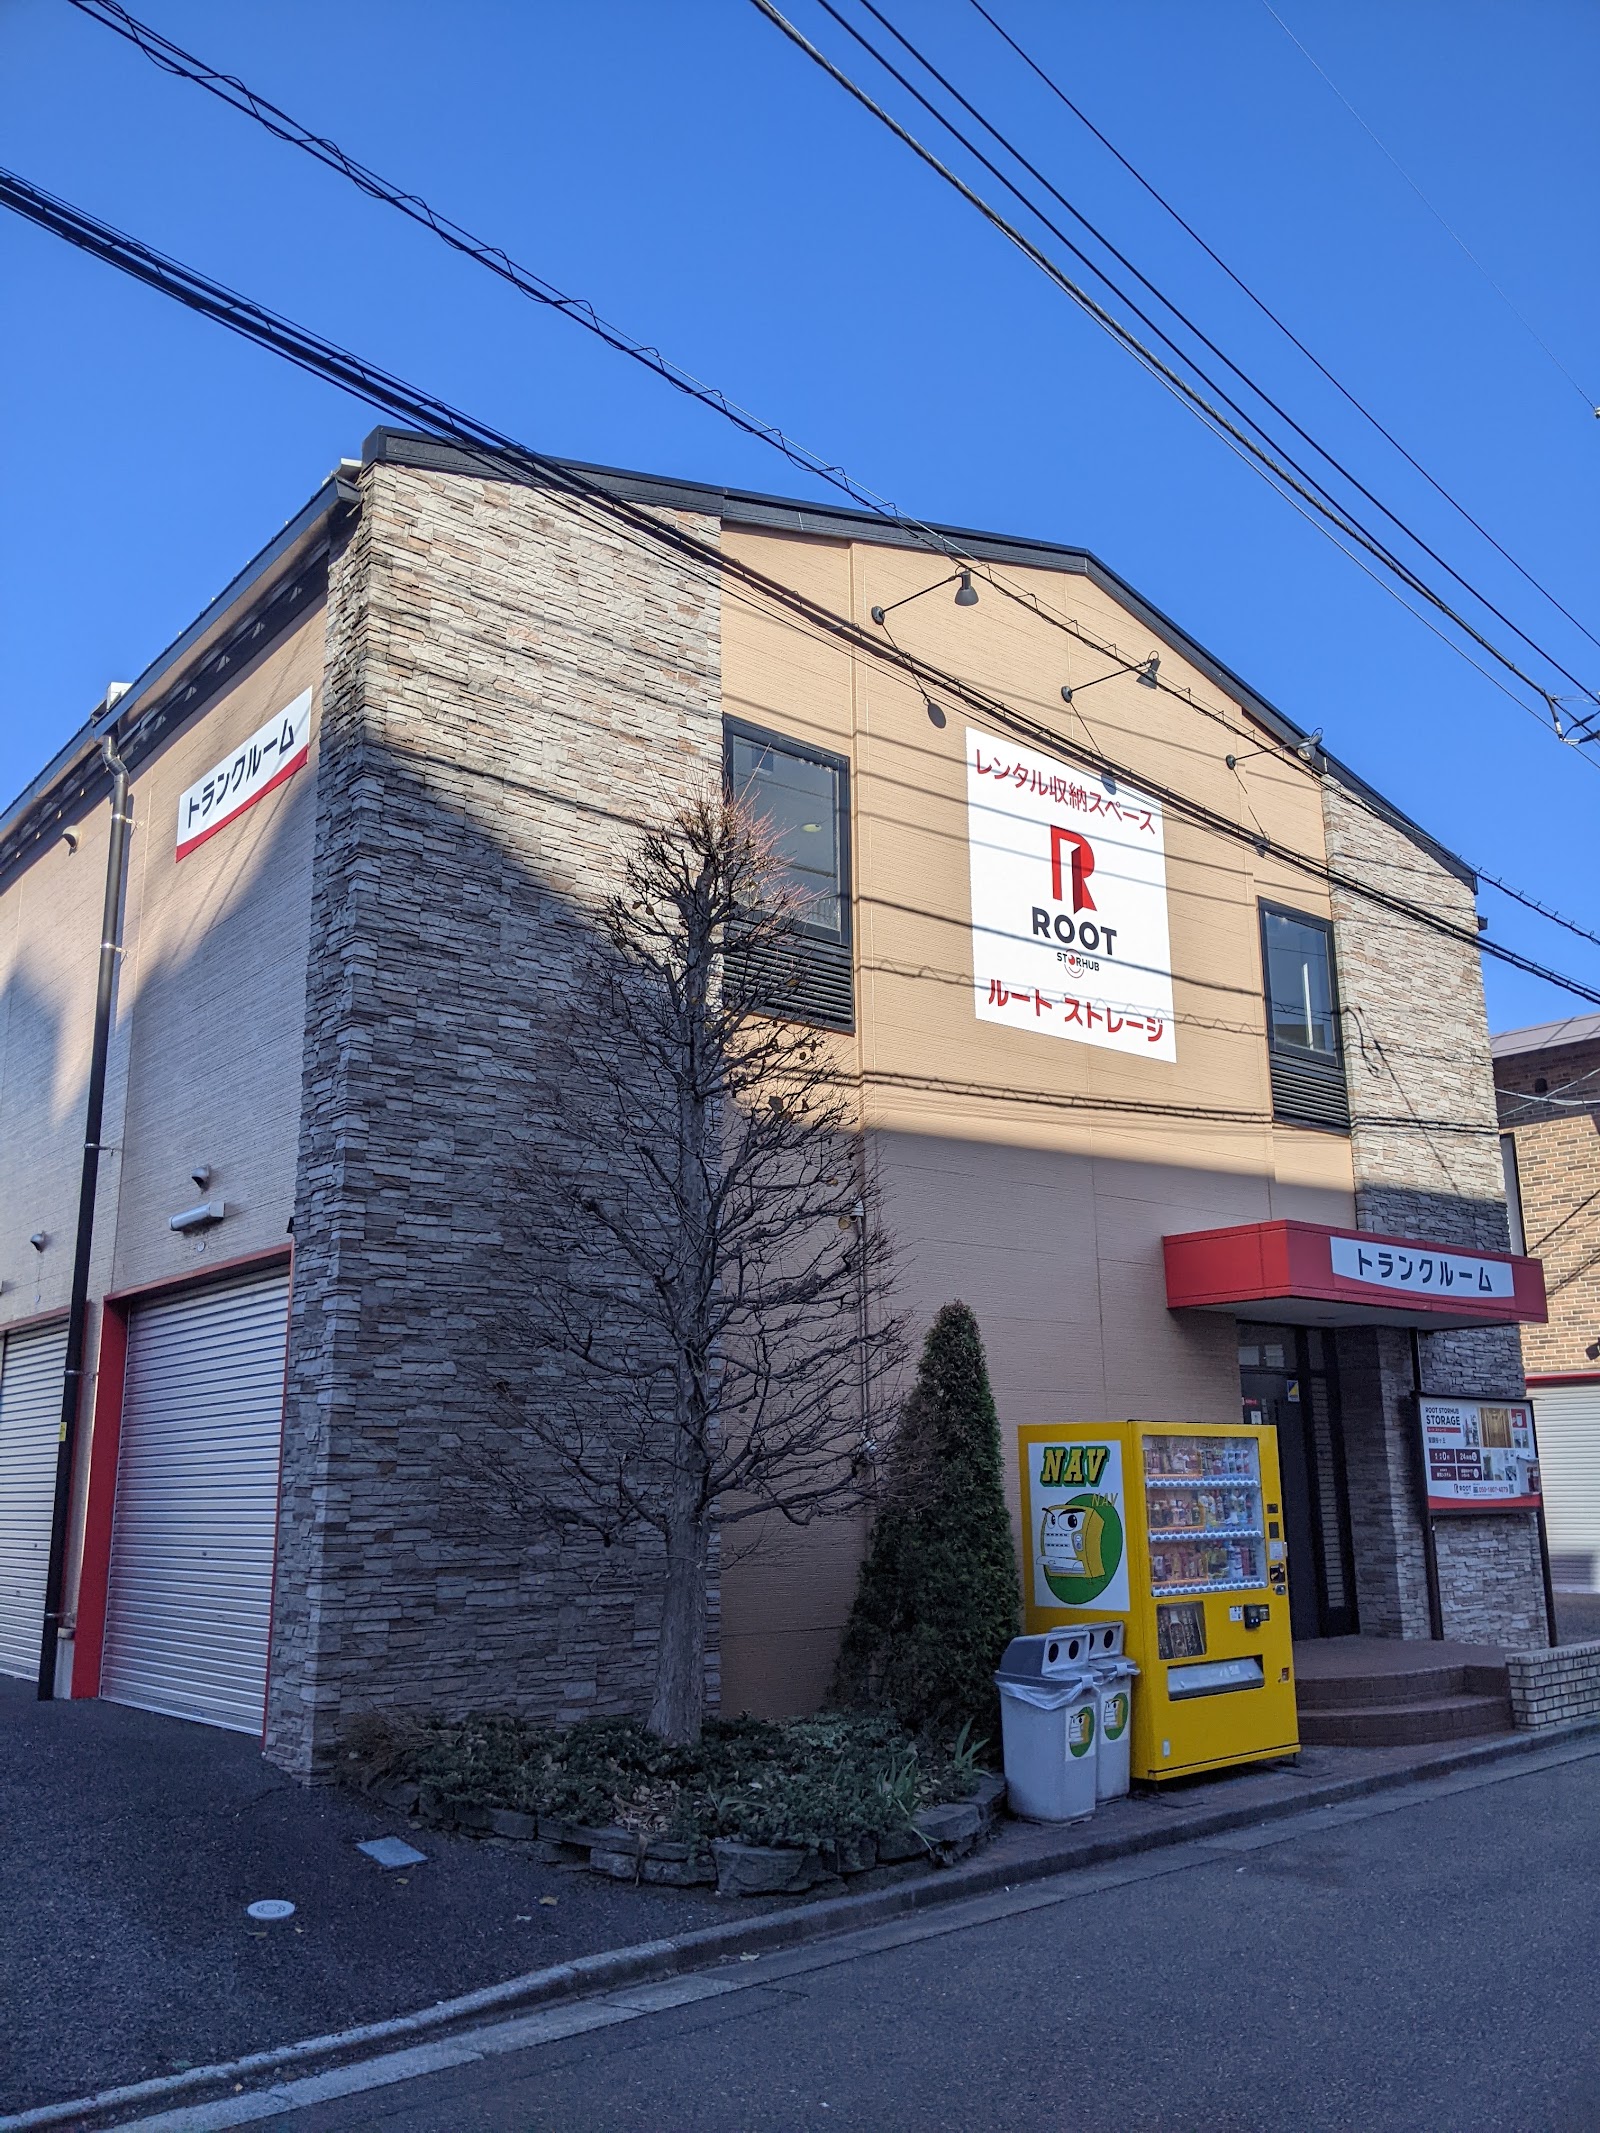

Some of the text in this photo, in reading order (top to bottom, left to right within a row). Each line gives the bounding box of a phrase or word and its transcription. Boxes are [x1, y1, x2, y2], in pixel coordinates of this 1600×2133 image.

[187, 717, 295, 829] トランクルーム
[976, 749, 1156, 835] レンタル収納スペース
[1031, 906, 1118, 956] ROOT
[1056, 952, 1100, 971] STORHUB
[1357, 1248, 1493, 1292] トランクルーム
[1426, 1415, 1461, 1426] STORAGE
[1040, 1446, 1111, 1487] NAV
